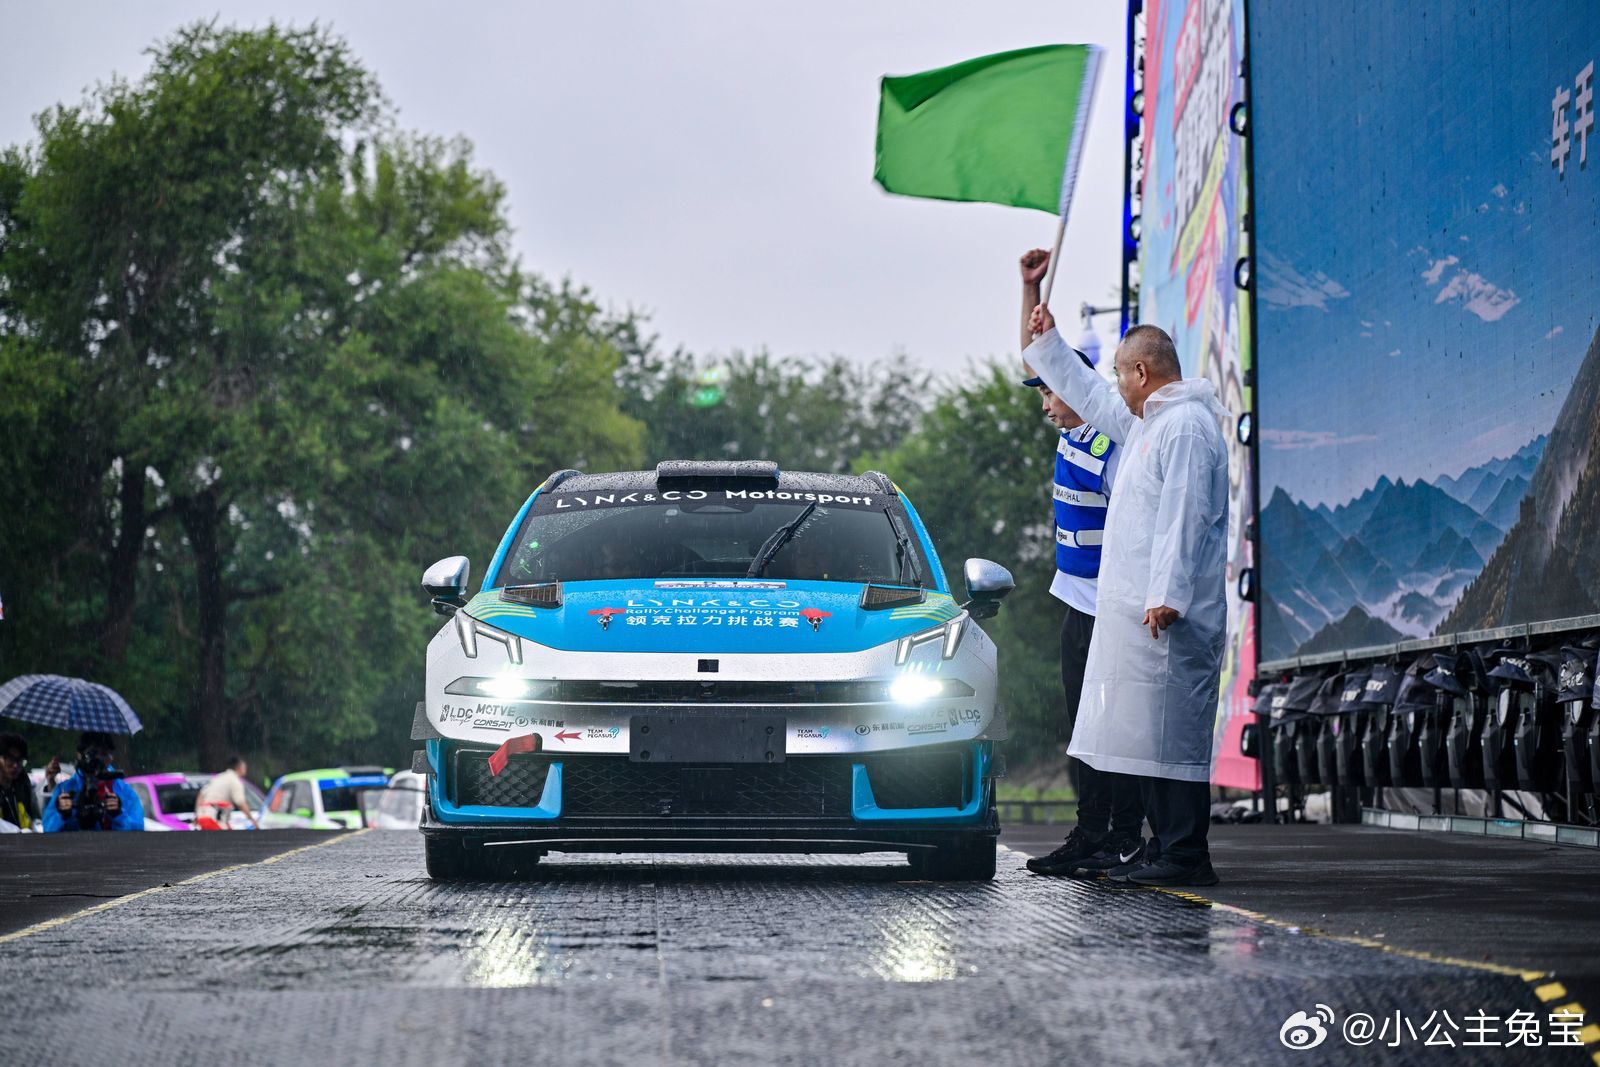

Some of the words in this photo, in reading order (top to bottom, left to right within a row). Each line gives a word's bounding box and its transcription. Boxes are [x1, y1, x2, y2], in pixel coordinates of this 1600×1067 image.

[1551, 59, 1594, 174] 车手
[725, 489, 873, 506] Motorsport
[740, 608, 800, 616] Program
[625, 615, 799, 628] 领克拉力挑战赛
